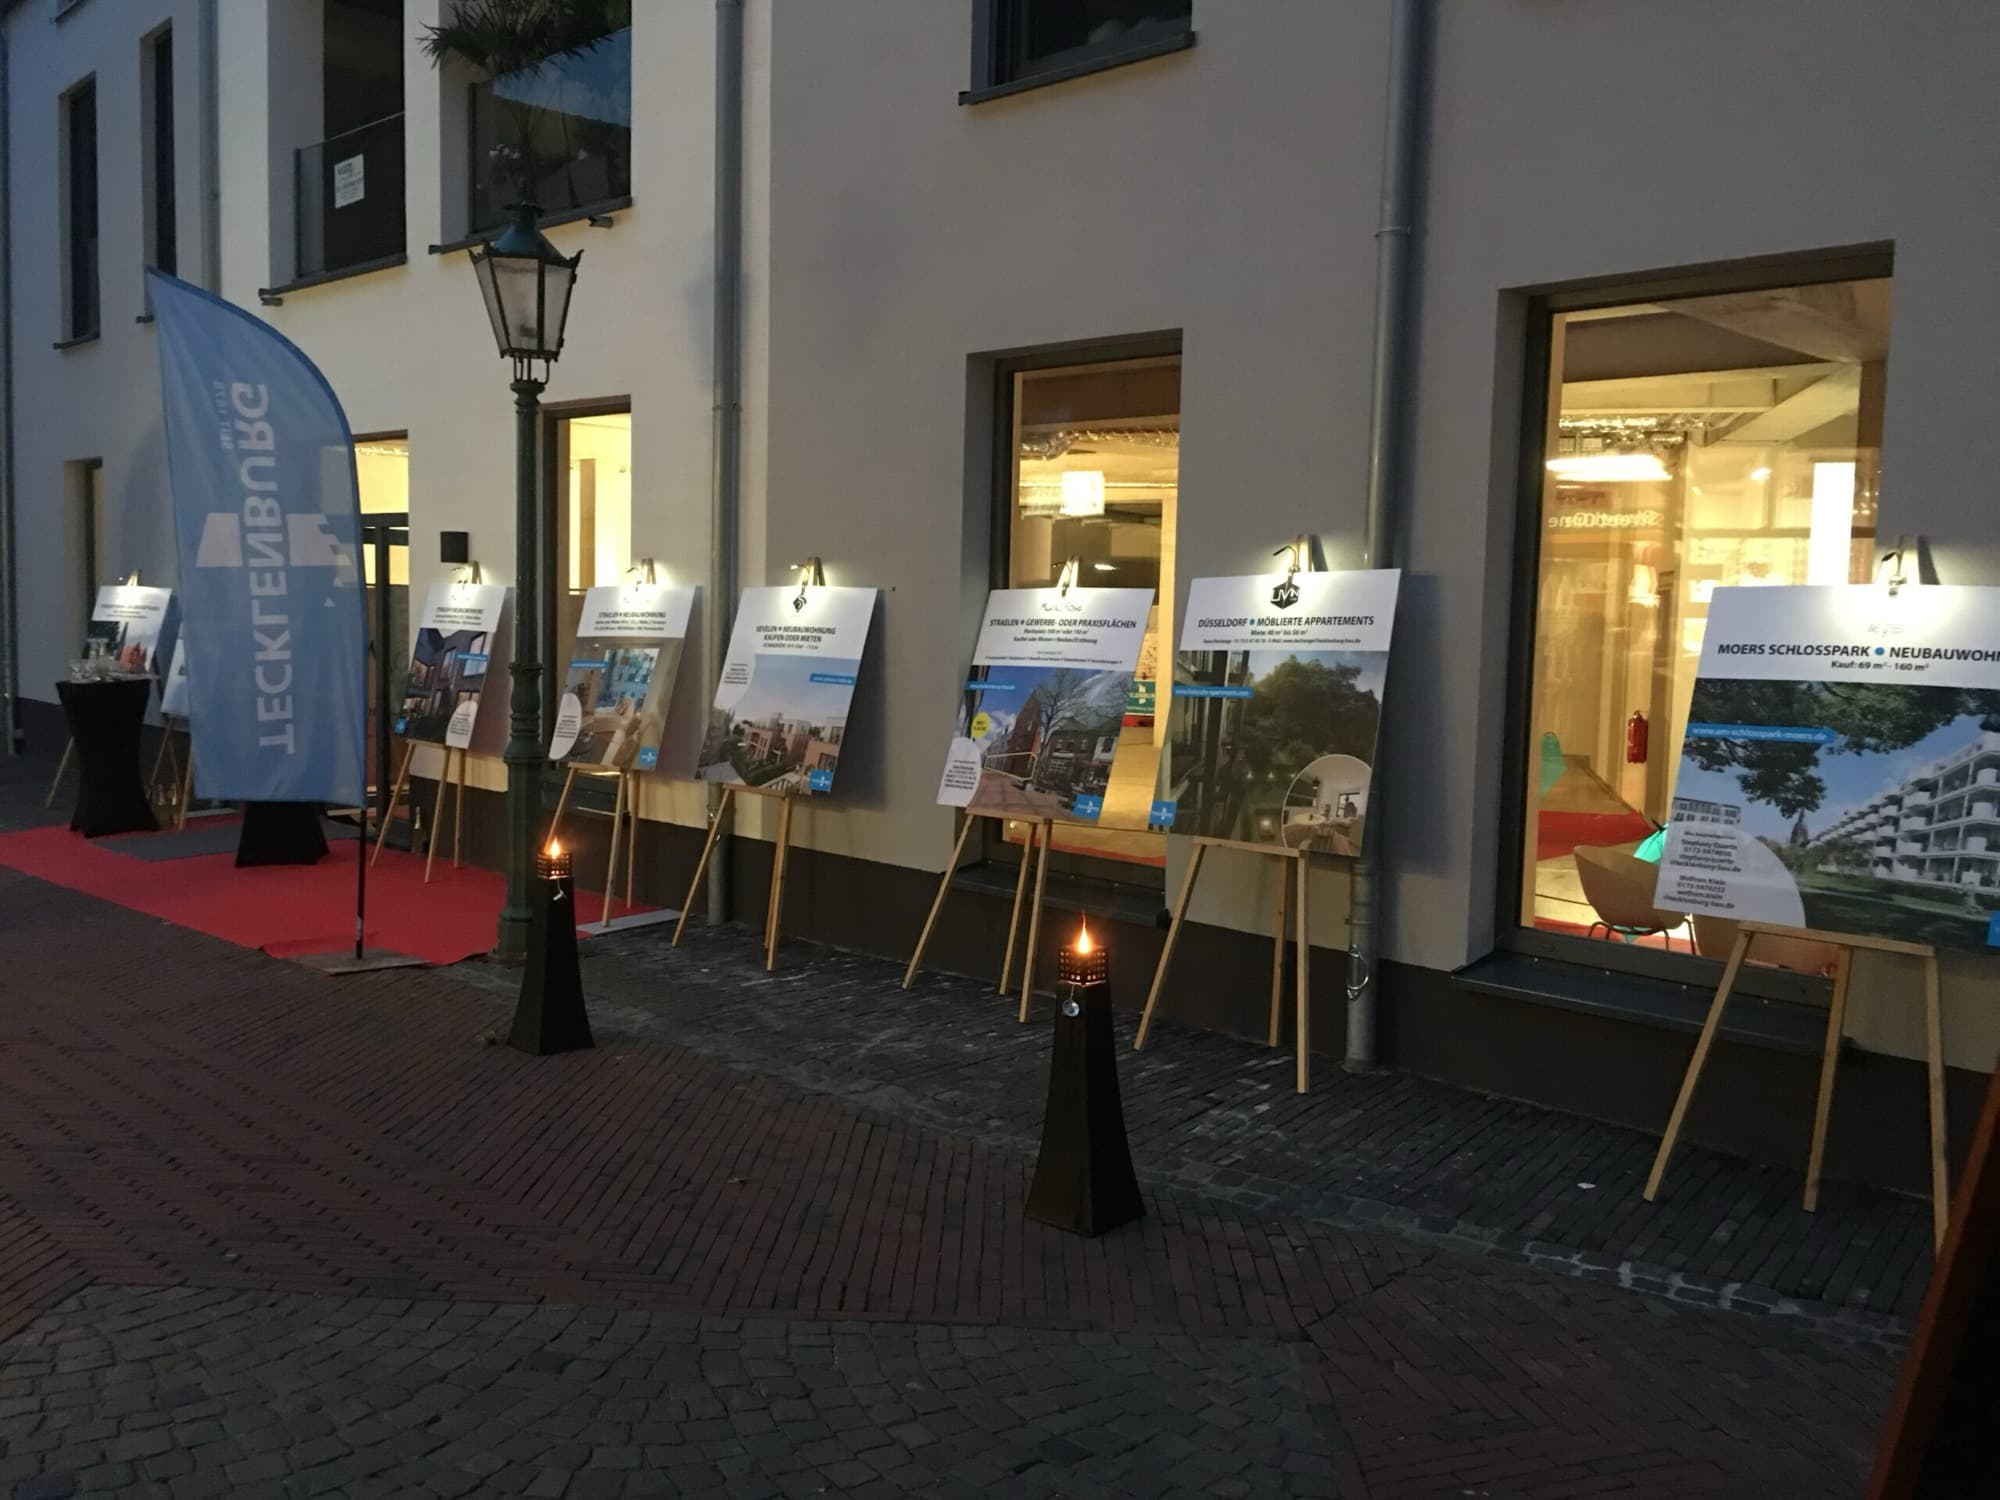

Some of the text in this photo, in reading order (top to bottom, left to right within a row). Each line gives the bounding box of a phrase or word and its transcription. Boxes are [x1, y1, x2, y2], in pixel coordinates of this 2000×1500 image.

[1078, 618, 1137, 629] PRAXISFLÄCHEN
[1198, 615, 1375, 628] DÜSSELDORF MÖBLIERTE APPARTEMENTS
[1718, 644, 1765, 656] MOERS
[1768, 644, 1870, 657] SCHLOSSPARK
[1831, 661, 1857, 670] Kauf:
[1858, 662, 1871, 670] 69
[1894, 663, 1913, 671] 160
